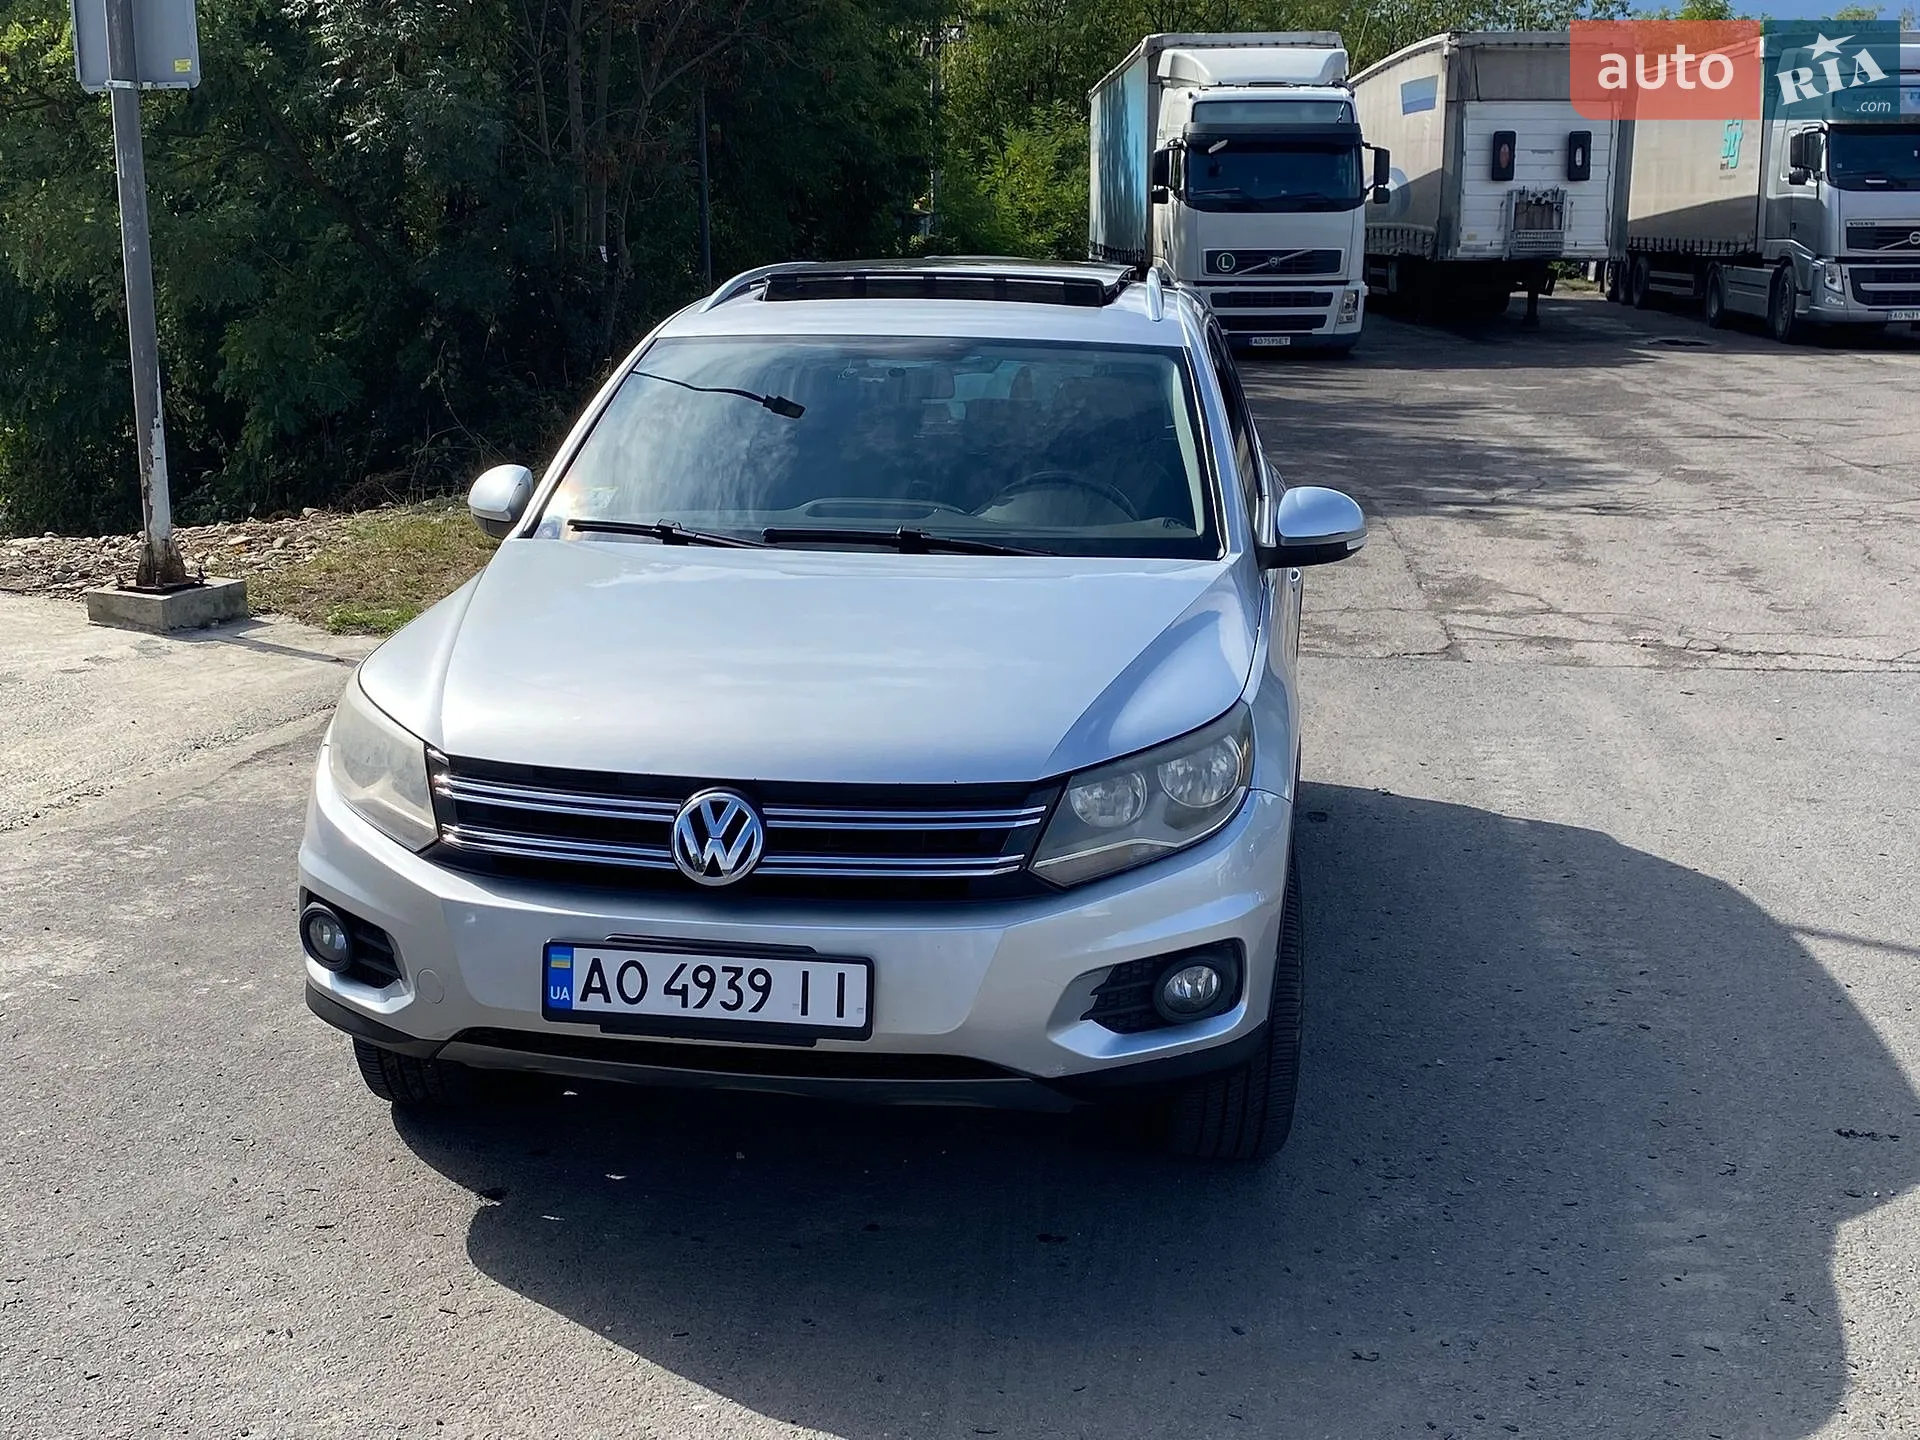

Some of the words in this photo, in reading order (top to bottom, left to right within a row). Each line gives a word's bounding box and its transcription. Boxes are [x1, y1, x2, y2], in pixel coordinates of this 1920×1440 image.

[1221, 256, 1230, 269] L
[550, 985, 570, 1001] UA
[579, 957, 649, 1006] AO
[663, 962, 773, 1013] 4939
